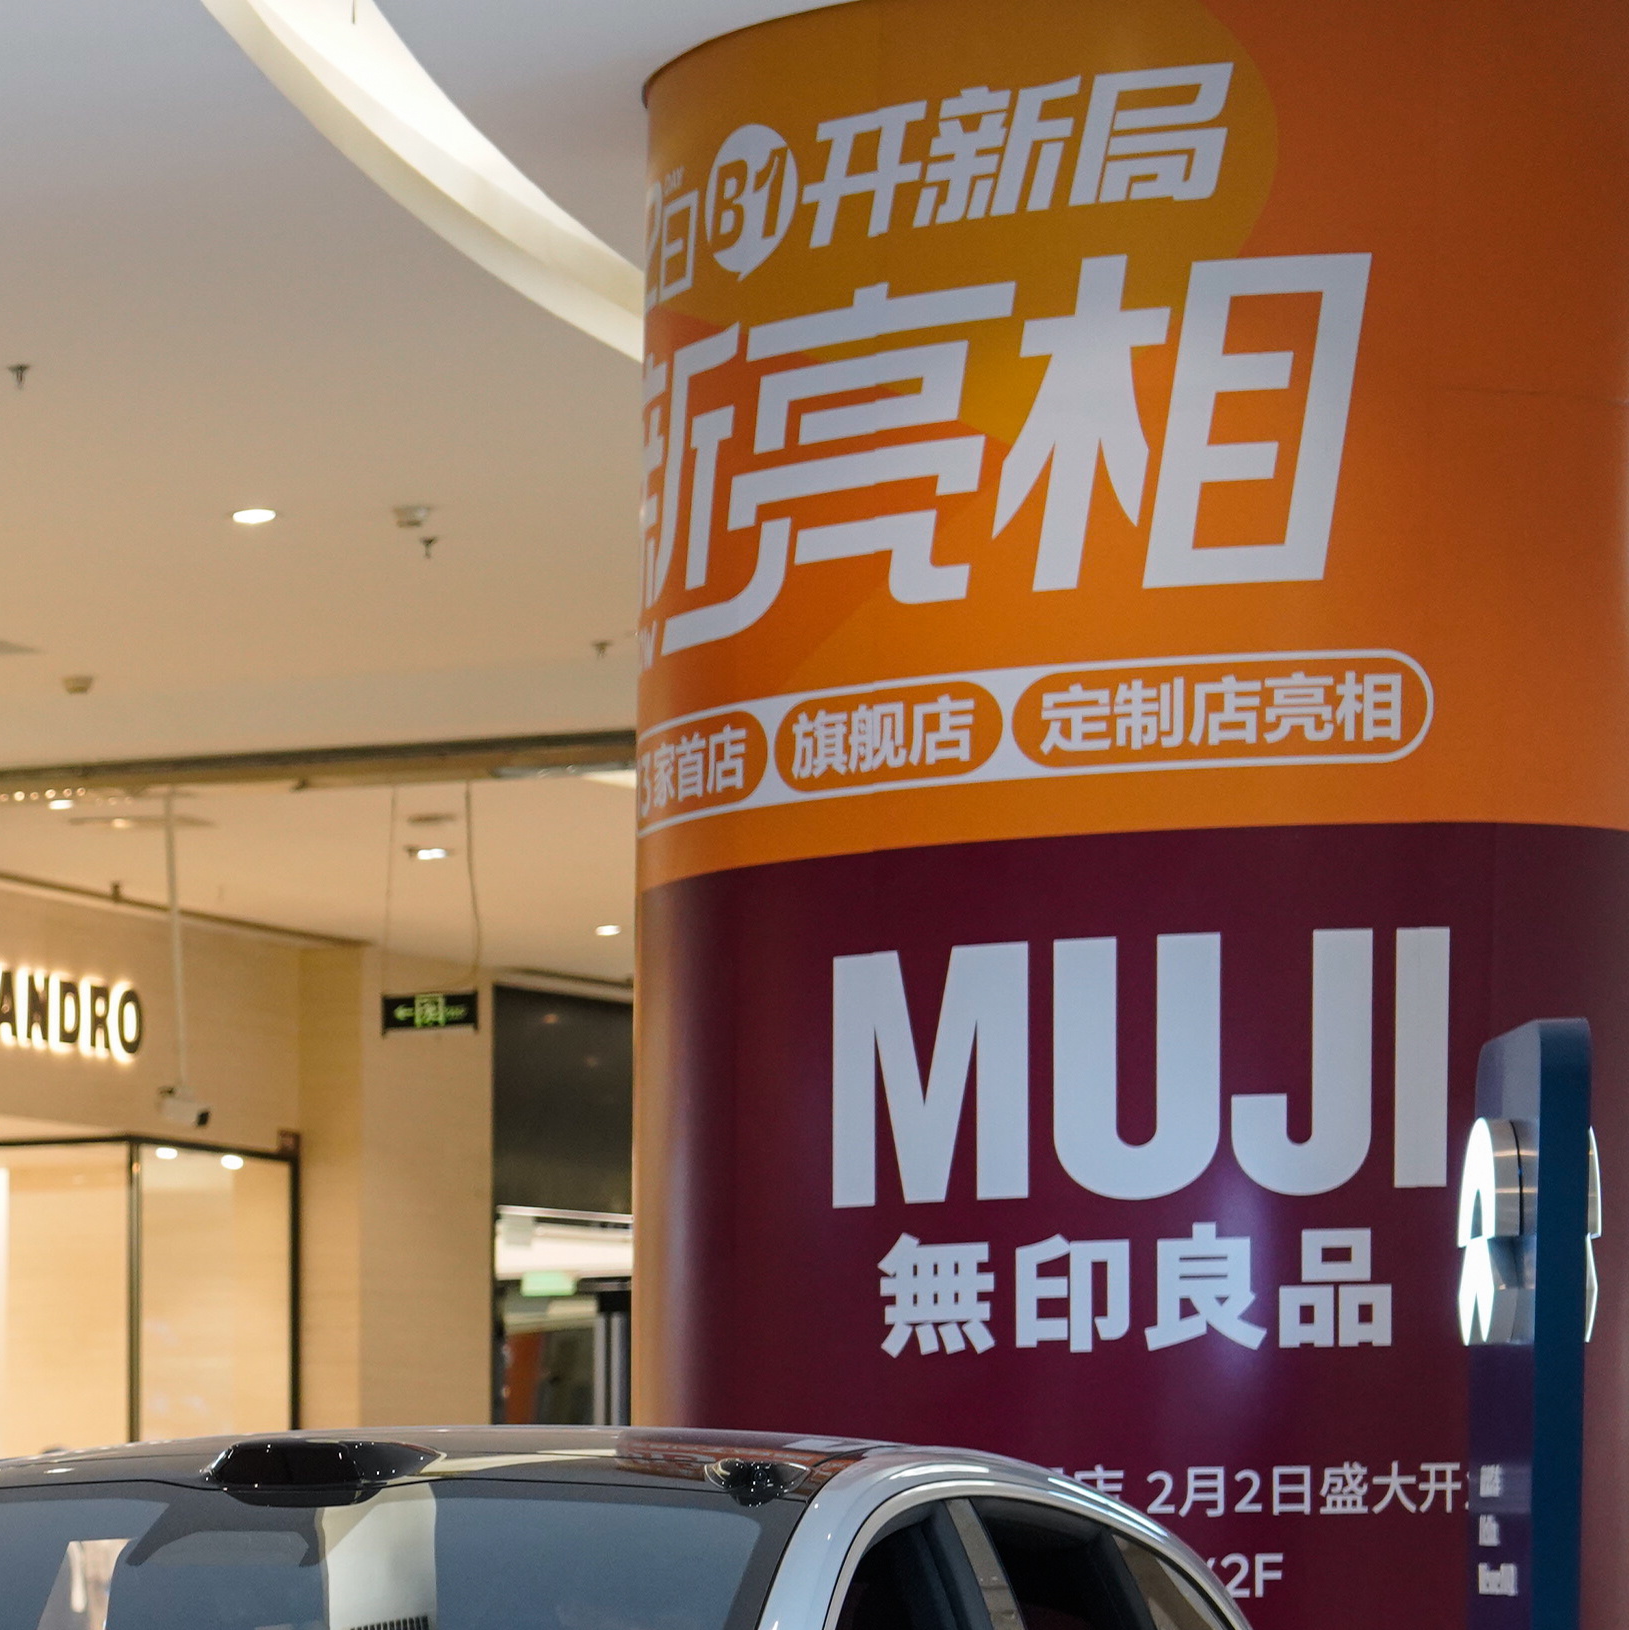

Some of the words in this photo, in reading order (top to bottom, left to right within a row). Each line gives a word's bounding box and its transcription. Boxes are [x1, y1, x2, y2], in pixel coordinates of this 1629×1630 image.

[800, 62, 1235, 250] 开新局
[791, 693, 976, 781] 旗舰店
[1039, 669, 1403, 755] 定制店亮相
[831, 926, 1451, 1209] MUJI
[878, 1221, 1394, 1358] 無印良品
[1146, 1460, 1470, 1518] 2月2日盛大开
